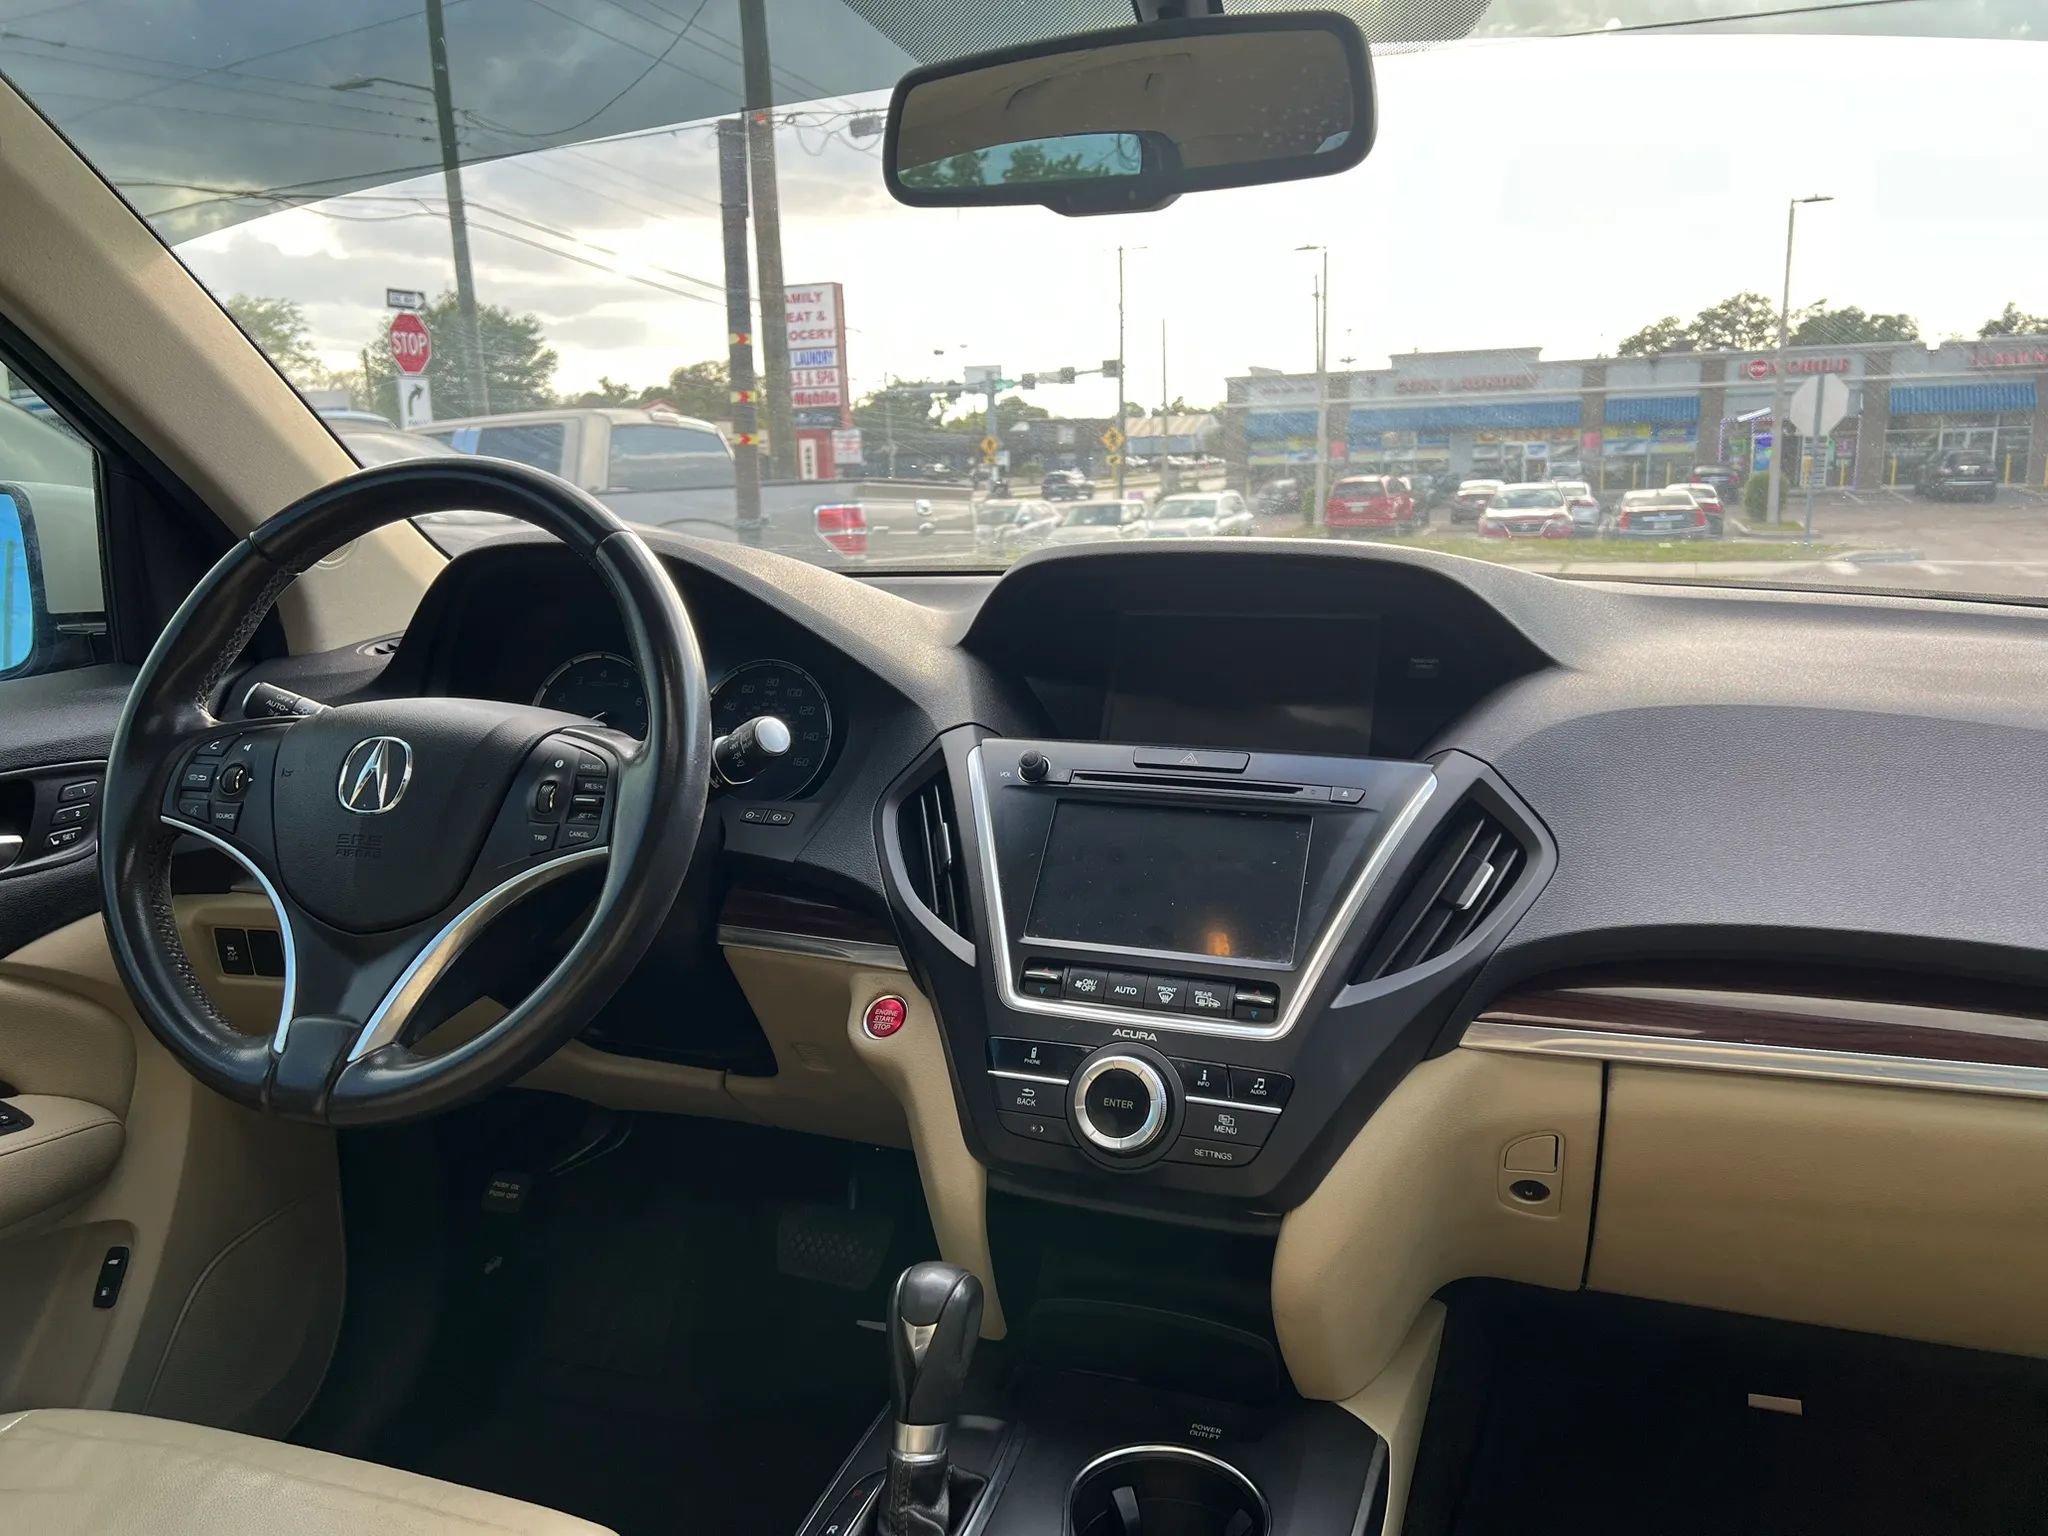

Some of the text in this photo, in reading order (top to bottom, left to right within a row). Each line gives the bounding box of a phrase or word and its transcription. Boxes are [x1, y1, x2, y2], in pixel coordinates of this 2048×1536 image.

[784, 292, 824, 304] AMILY
[785, 311, 828, 323] EAT &
[789, 329, 833, 342] OCERY
[392, 331, 428, 356] STOP
[794, 351, 834, 366] LAUNDRY
[265, 699, 285, 711] AUTO
[62, 833, 76, 841] SET
[1114, 985, 1137, 995] AUTO
[875, 1009, 899, 1017] ENGINE
[1112, 1028, 1157, 1042] ACURA
[1017, 1097, 1036, 1107] BACK
[1103, 1097, 1134, 1110] ENTER
[1214, 1125, 1237, 1135] MENU
[1194, 1149, 1232, 1160] SETTINGS
[1191, 1423, 1222, 1434] POWER
[1190, 1429, 1220, 1440] OUTLET
[826, 1525, 839, 1535] R
